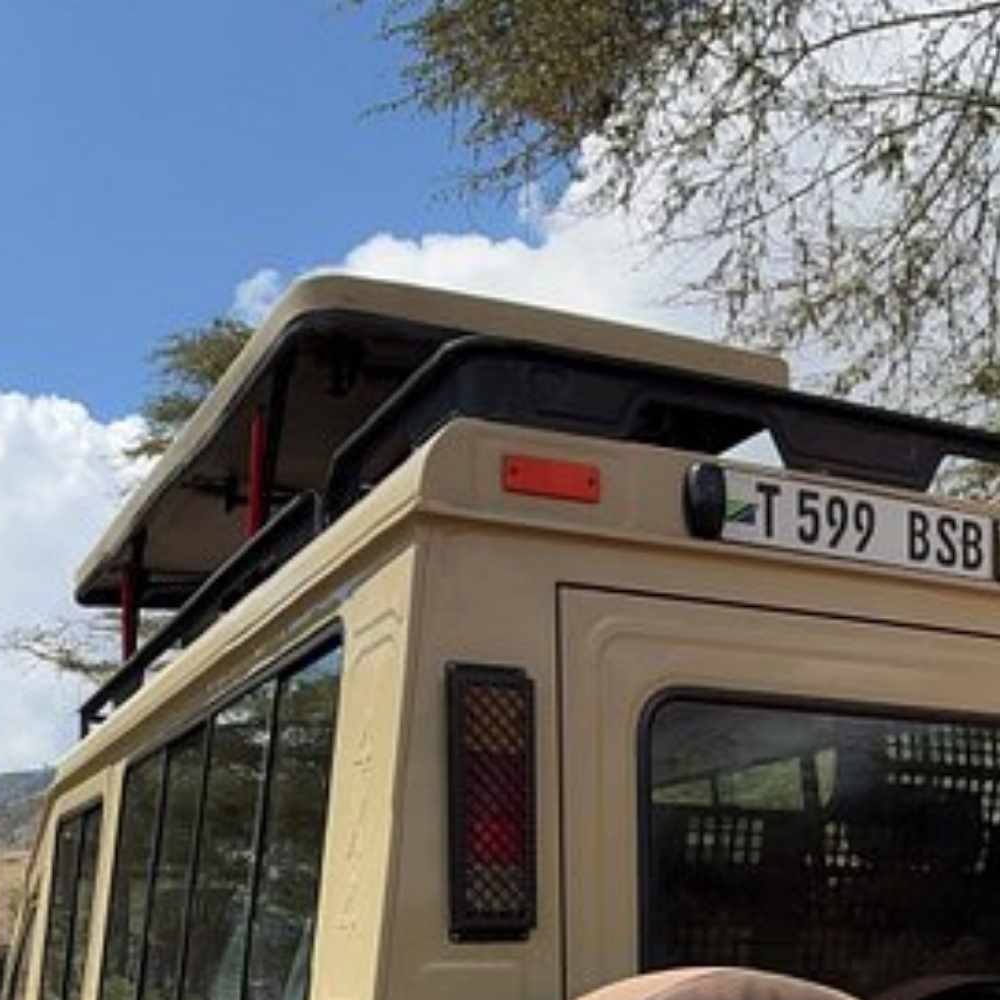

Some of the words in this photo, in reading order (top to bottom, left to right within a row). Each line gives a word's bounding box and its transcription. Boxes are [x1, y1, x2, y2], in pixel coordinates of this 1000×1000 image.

[756, 481, 780, 538] T
[796, 489, 875, 552] 599
[908, 510, 983, 570] BSB
